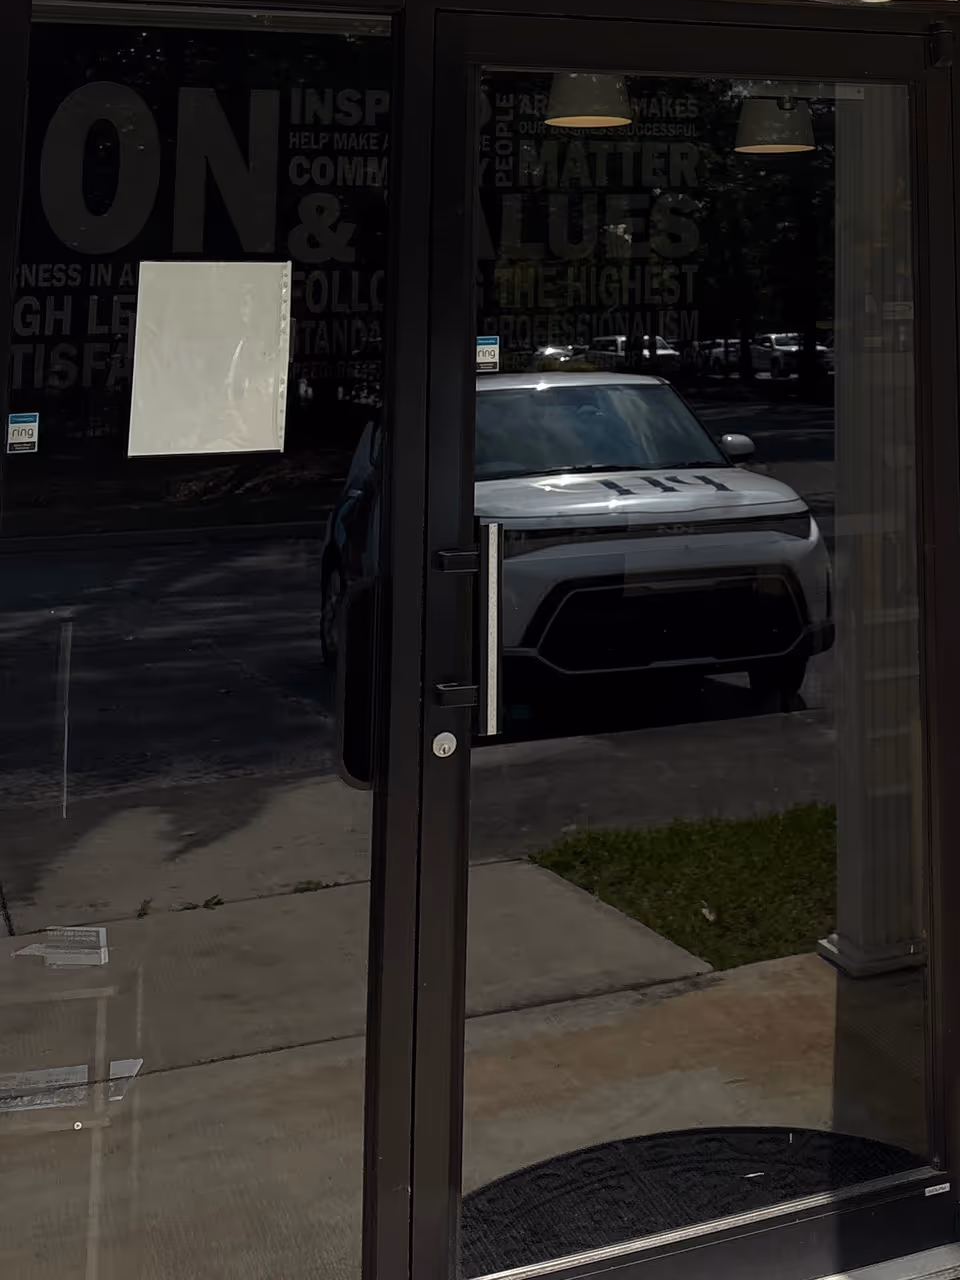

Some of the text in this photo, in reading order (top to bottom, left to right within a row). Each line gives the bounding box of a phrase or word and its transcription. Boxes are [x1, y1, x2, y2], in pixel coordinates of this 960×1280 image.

[288, 131, 328, 150] HELP
[332, 131, 380, 151] MAKE
[495, 93, 514, 187] PEOPLE
[519, 120, 546, 136] OUR
[617, 122, 698, 138] SUCCESSFUL
[39, 80, 281, 256] ON
[518, 138, 700, 188] MATTER
[287, 192, 357, 264] &
[88, 263, 113, 289] IN
[566, 264, 699, 307] HIGHEST
[13, 295, 73, 337] GH
[294, 318, 383, 356] TANDA
[478, 349, 496, 360] ring
[12, 427, 34, 439] ring
